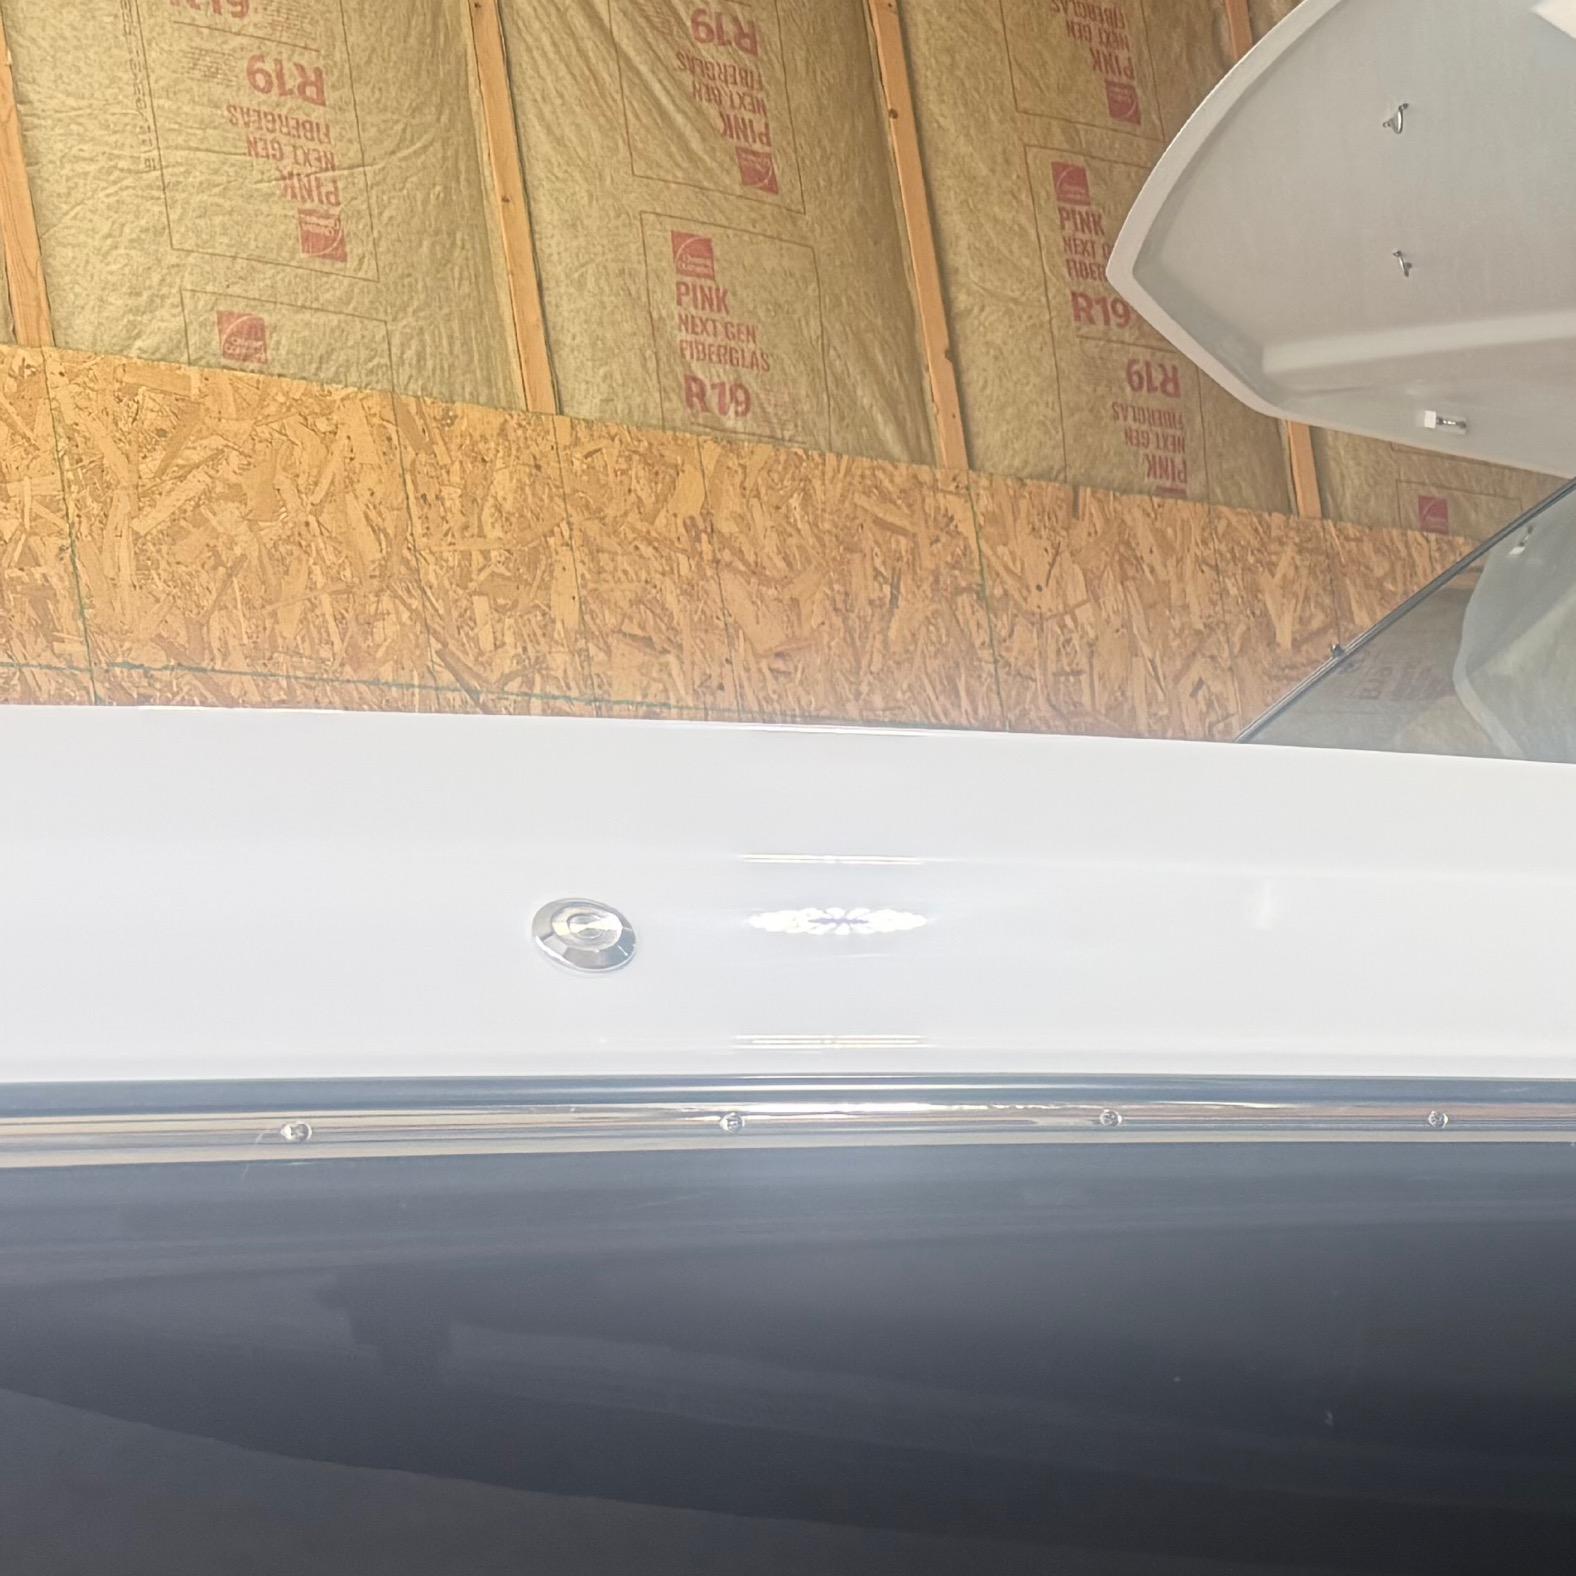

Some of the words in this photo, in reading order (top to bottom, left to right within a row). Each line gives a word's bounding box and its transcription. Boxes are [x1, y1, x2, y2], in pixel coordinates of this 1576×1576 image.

[691, 8, 759, 57] R19
[246, 54, 326, 107] R19
[676, 51, 764, 92] FIBERGLAS
[1089, 47, 1135, 80] PINK
[226, 104, 332, 145] FIBERGLAS
[719, 111, 772, 147] PINK
[247, 135, 284, 162] GEN
[292, 144, 336, 172] NEXT
[277, 170, 342, 207] PINK
[1058, 206, 1105, 236] PINK
[1063, 236, 1097, 260] NEXT
[676, 281, 729, 315] PINK
[1071, 291, 1131, 328] R19
[678, 313, 718, 338] NEXT
[725, 321, 758, 344] GEN
[679, 339, 770, 373] FIBERGLAS
[1126, 358, 1181, 398] R19
[684, 374, 751, 418] R19
[1112, 401, 1185, 430] FIBERGLAS
[1144, 453, 1187, 484] PINK
